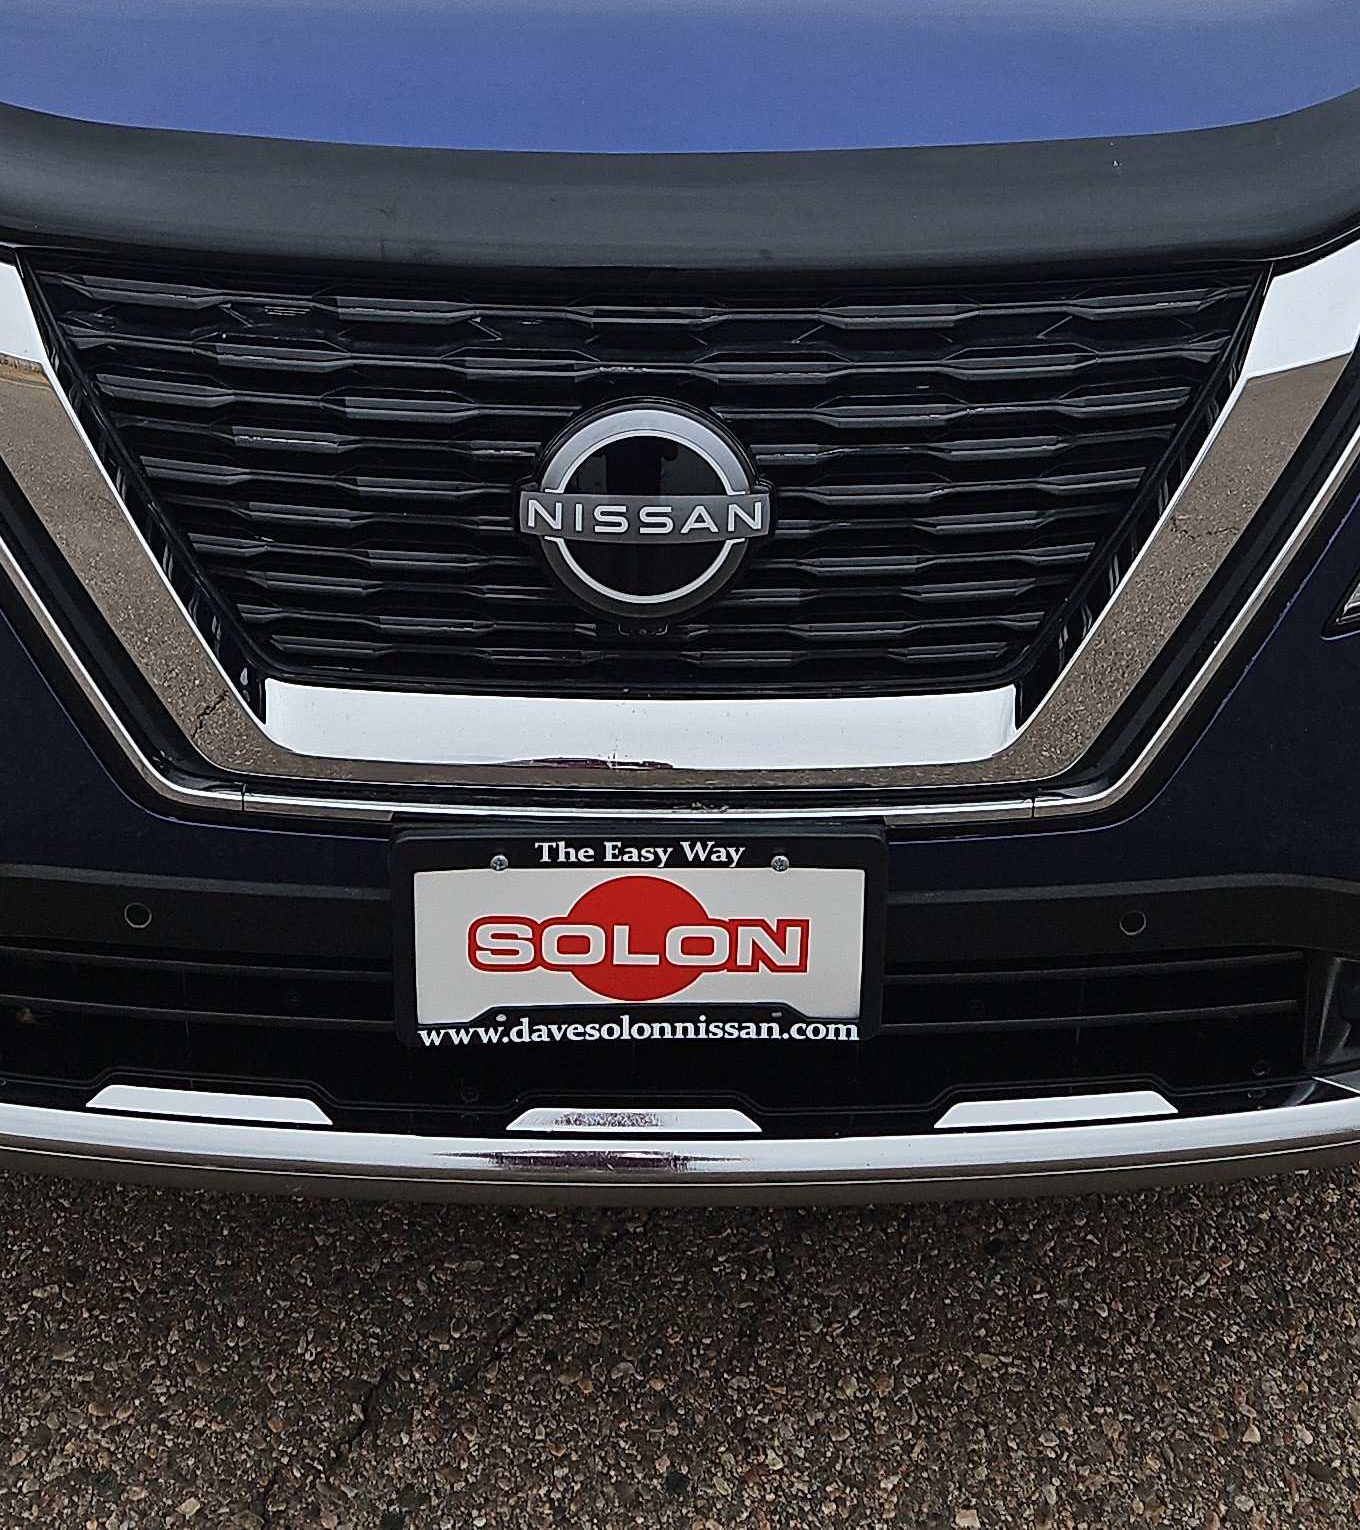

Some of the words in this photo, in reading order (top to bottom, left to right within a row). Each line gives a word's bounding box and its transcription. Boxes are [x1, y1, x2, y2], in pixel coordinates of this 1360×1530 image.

[526, 499, 762, 534] NISSAN
[534, 841, 595, 864] The
[603, 841, 673, 869] Easy
[679, 841, 746, 869] Way
[471, 919, 807, 970] SOLON
[417, 1015, 860, 1047] www.davesolonnissan.com
